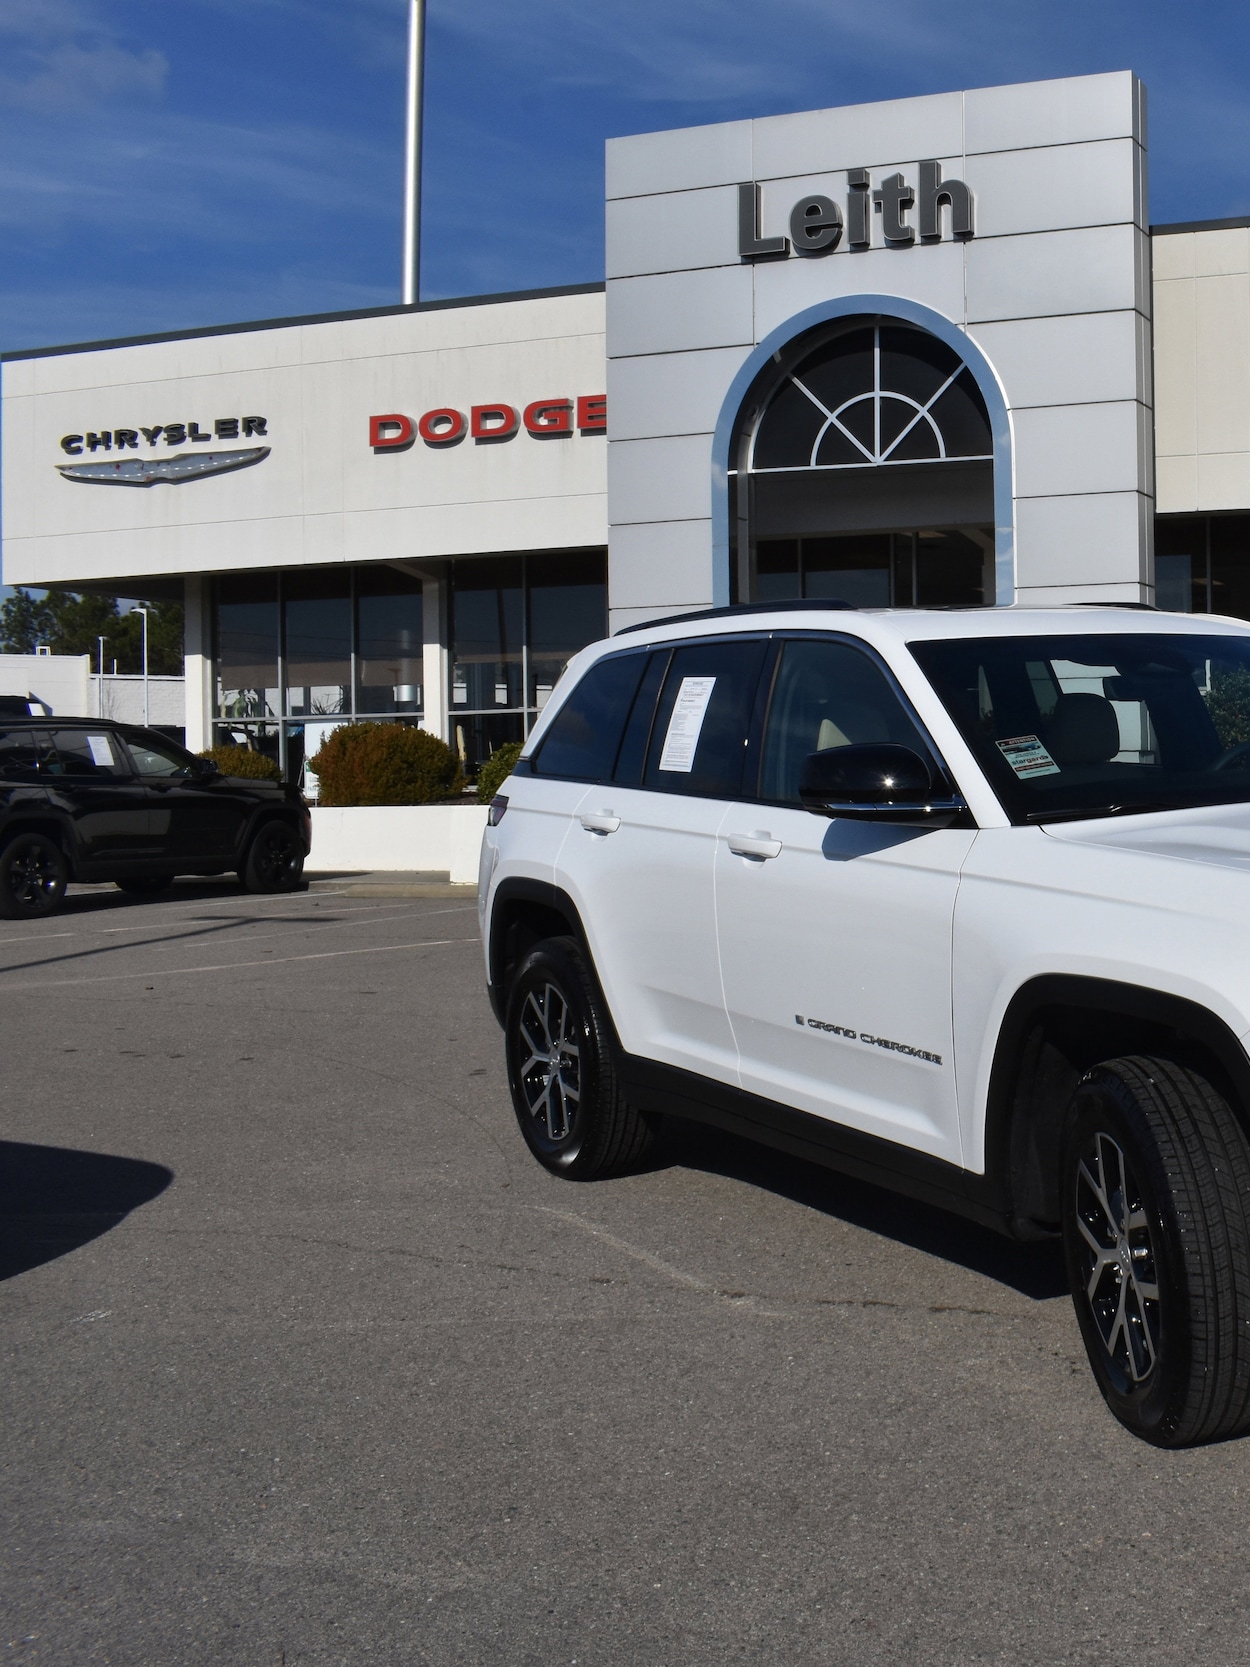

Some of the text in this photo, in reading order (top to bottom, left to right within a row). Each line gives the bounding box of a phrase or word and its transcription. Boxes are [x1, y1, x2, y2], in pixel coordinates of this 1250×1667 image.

[737, 160, 974, 260] Leith
[60, 416, 267, 455] CHRYSLER
[369, 394, 607, 452] DODGE
[807, 1018, 943, 1066] GRAND CHEROKEE
